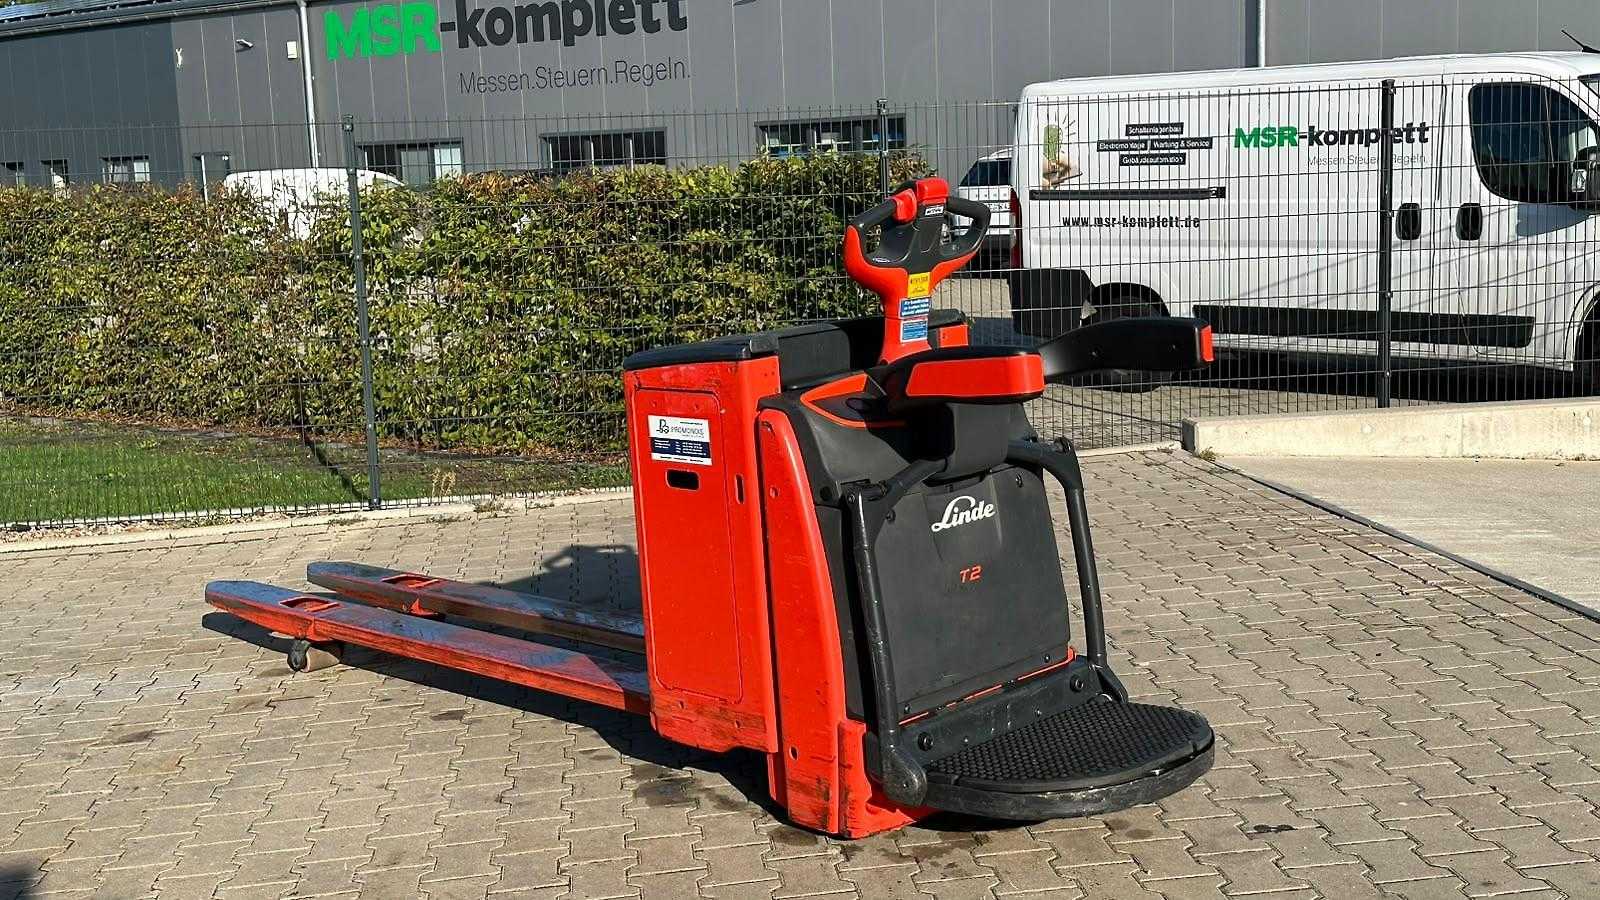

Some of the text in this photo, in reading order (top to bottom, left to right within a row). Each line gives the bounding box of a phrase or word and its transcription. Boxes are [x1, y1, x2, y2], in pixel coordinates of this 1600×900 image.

[324, 0, 689, 60] MSR-komplett
[1234, 122, 1430, 148] MSR-kompett
[1062, 214, 1201, 230] www.msr-komplett.de
[931, 495, 996, 533] Linde
[960, 565, 983, 584] T2
